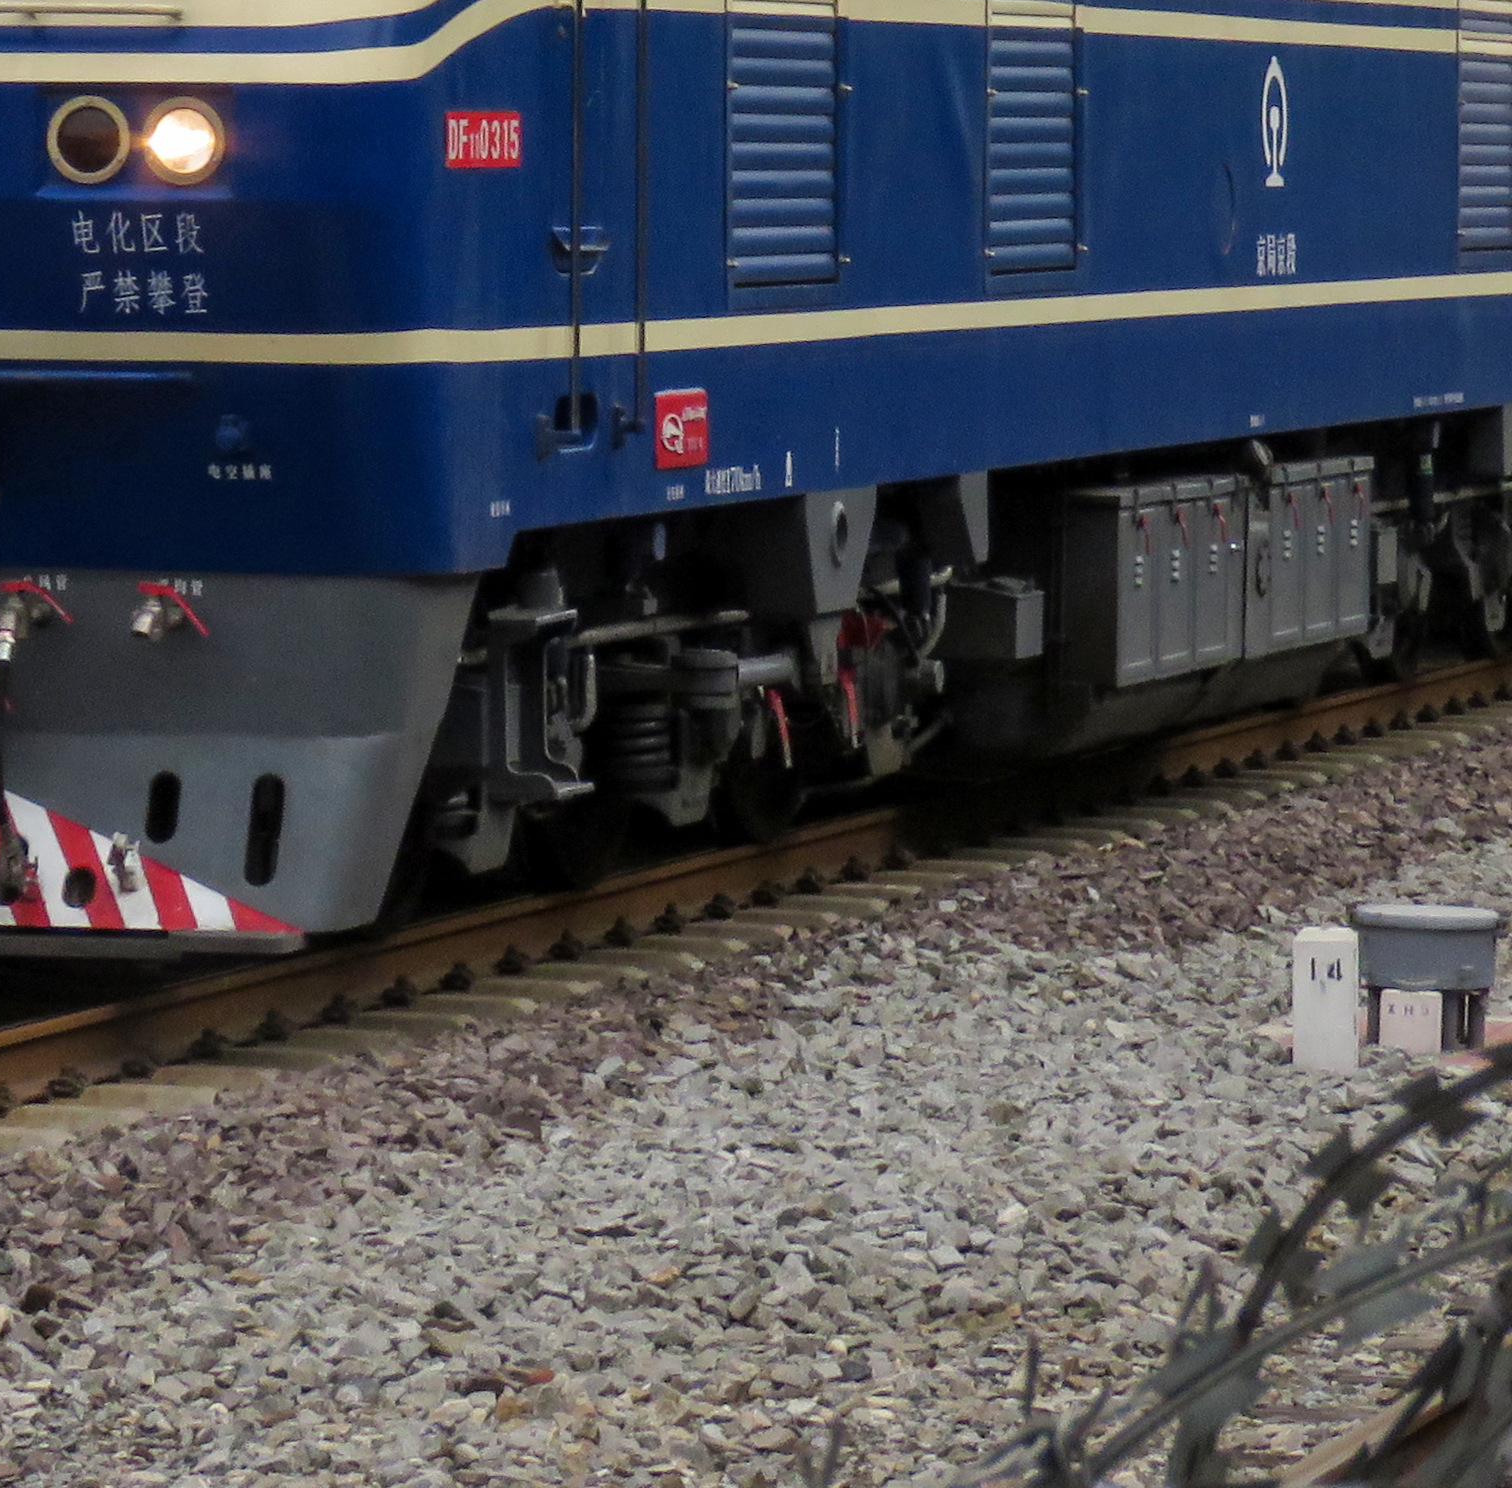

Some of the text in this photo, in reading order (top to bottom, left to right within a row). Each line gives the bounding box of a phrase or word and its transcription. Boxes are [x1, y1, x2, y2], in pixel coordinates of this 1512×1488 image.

[72, 211, 204, 253] 电化区段
[80, 270, 208, 315] 严禁攀登
[1310, 957, 1343, 982] 14
